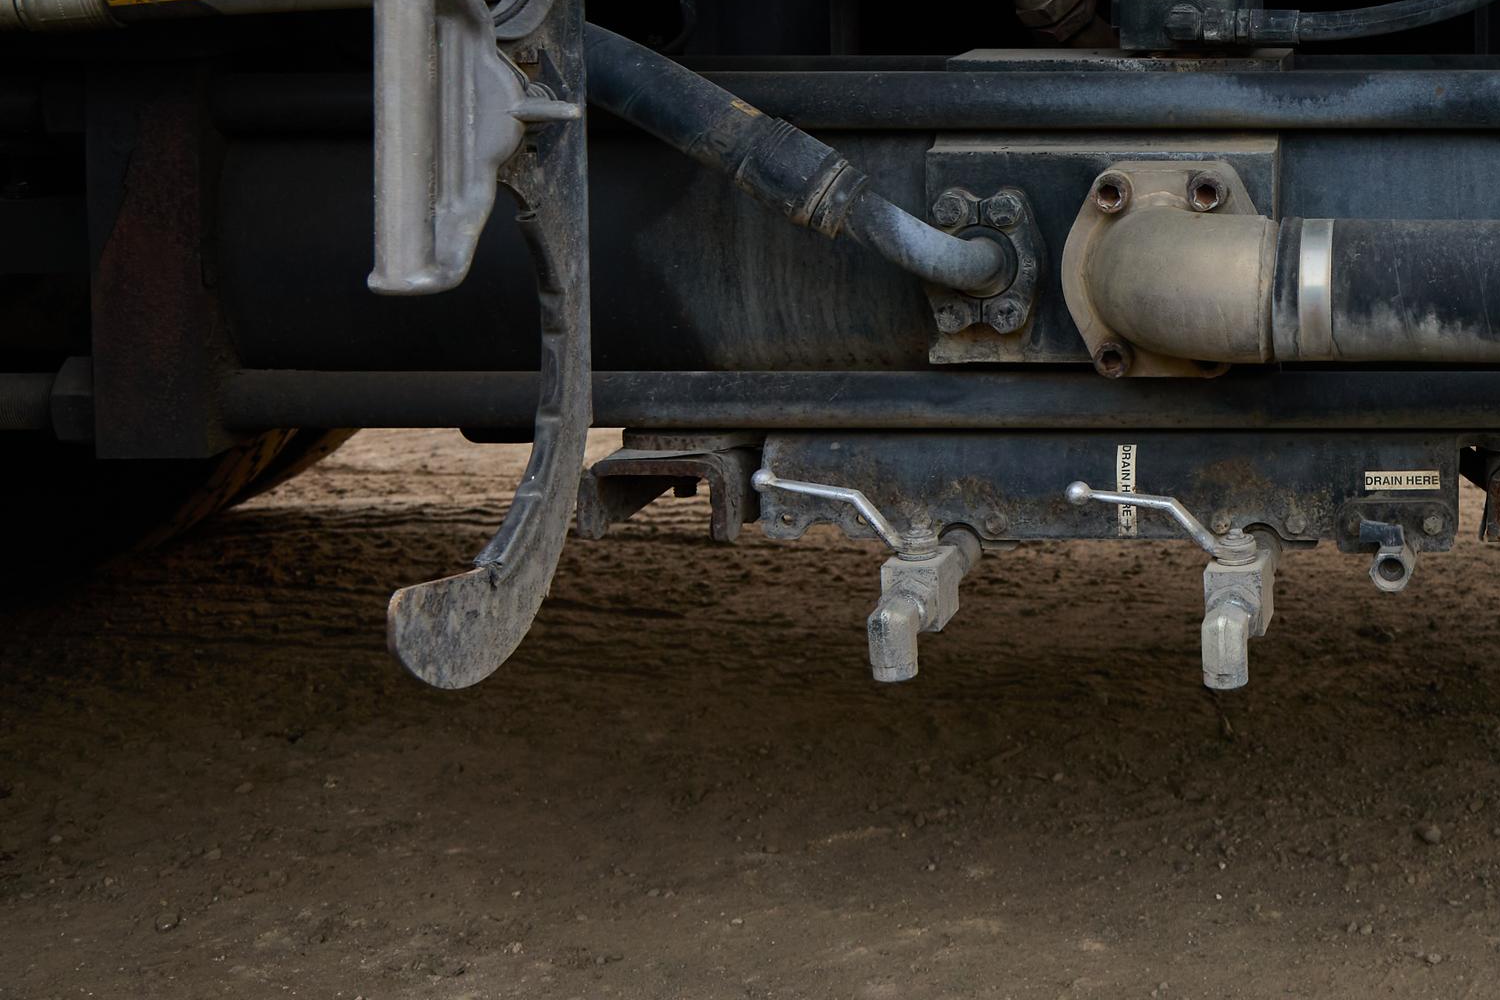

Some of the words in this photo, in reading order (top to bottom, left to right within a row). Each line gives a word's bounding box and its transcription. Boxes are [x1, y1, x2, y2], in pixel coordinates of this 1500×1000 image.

[1121, 445, 1132, 481] DRAIN
[1365, 476, 1403, 487] DRAIN
[1405, 474, 1440, 486] HERE
[1121, 484, 1132, 517] HRE
